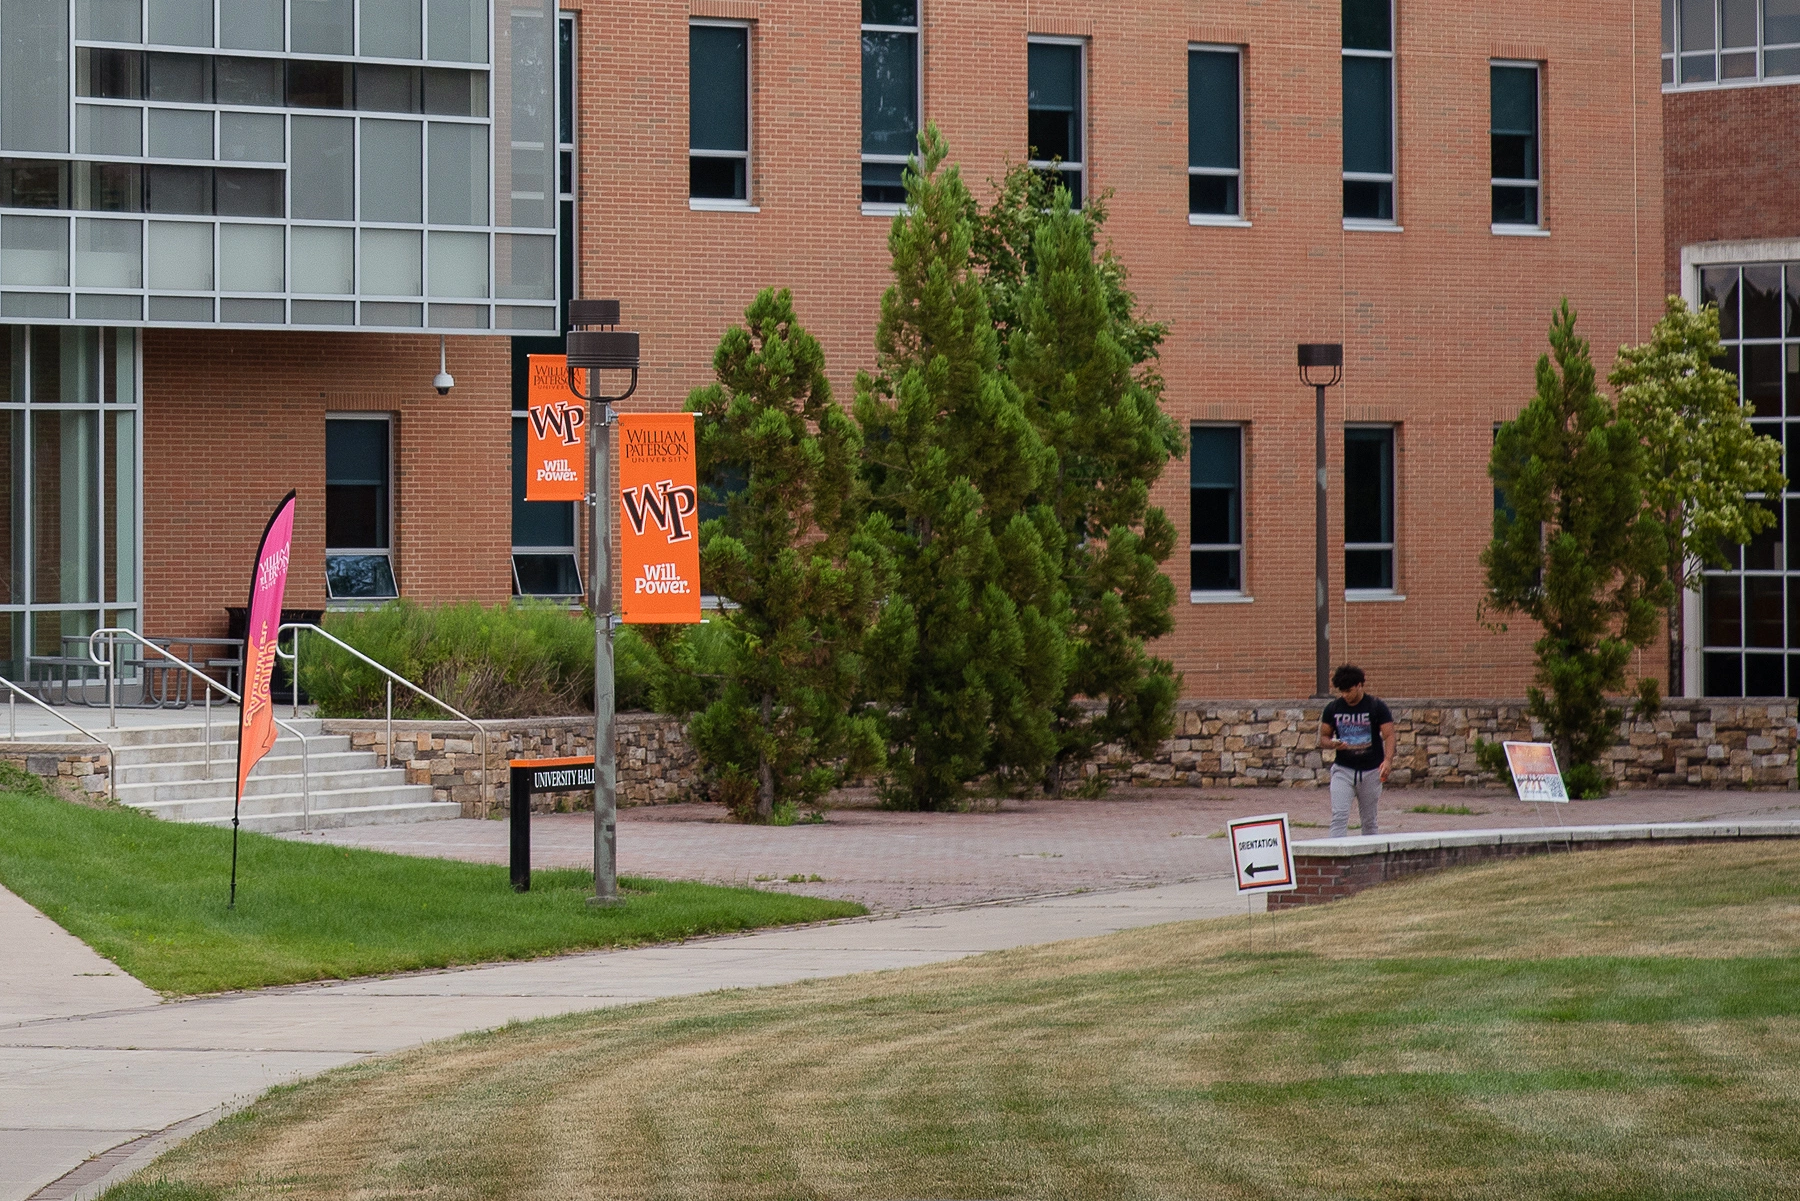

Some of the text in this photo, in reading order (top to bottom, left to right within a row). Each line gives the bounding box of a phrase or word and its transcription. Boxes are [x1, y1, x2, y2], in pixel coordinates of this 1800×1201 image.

[533, 375, 582, 386] PATERSN
[530, 401, 585, 446] WP
[626, 429, 687, 444] WILLIAM
[625, 442, 689, 458] PATERSON
[543, 459, 571, 472] Will.
[536, 469, 578, 481] Power.
[622, 479, 696, 544] WP
[643, 563, 681, 581] Will.
[634, 577, 691, 594] Power.
[534, 768, 595, 788] UNIVERSITY HALL
[1238, 838, 1279, 851] ORIENTATION
